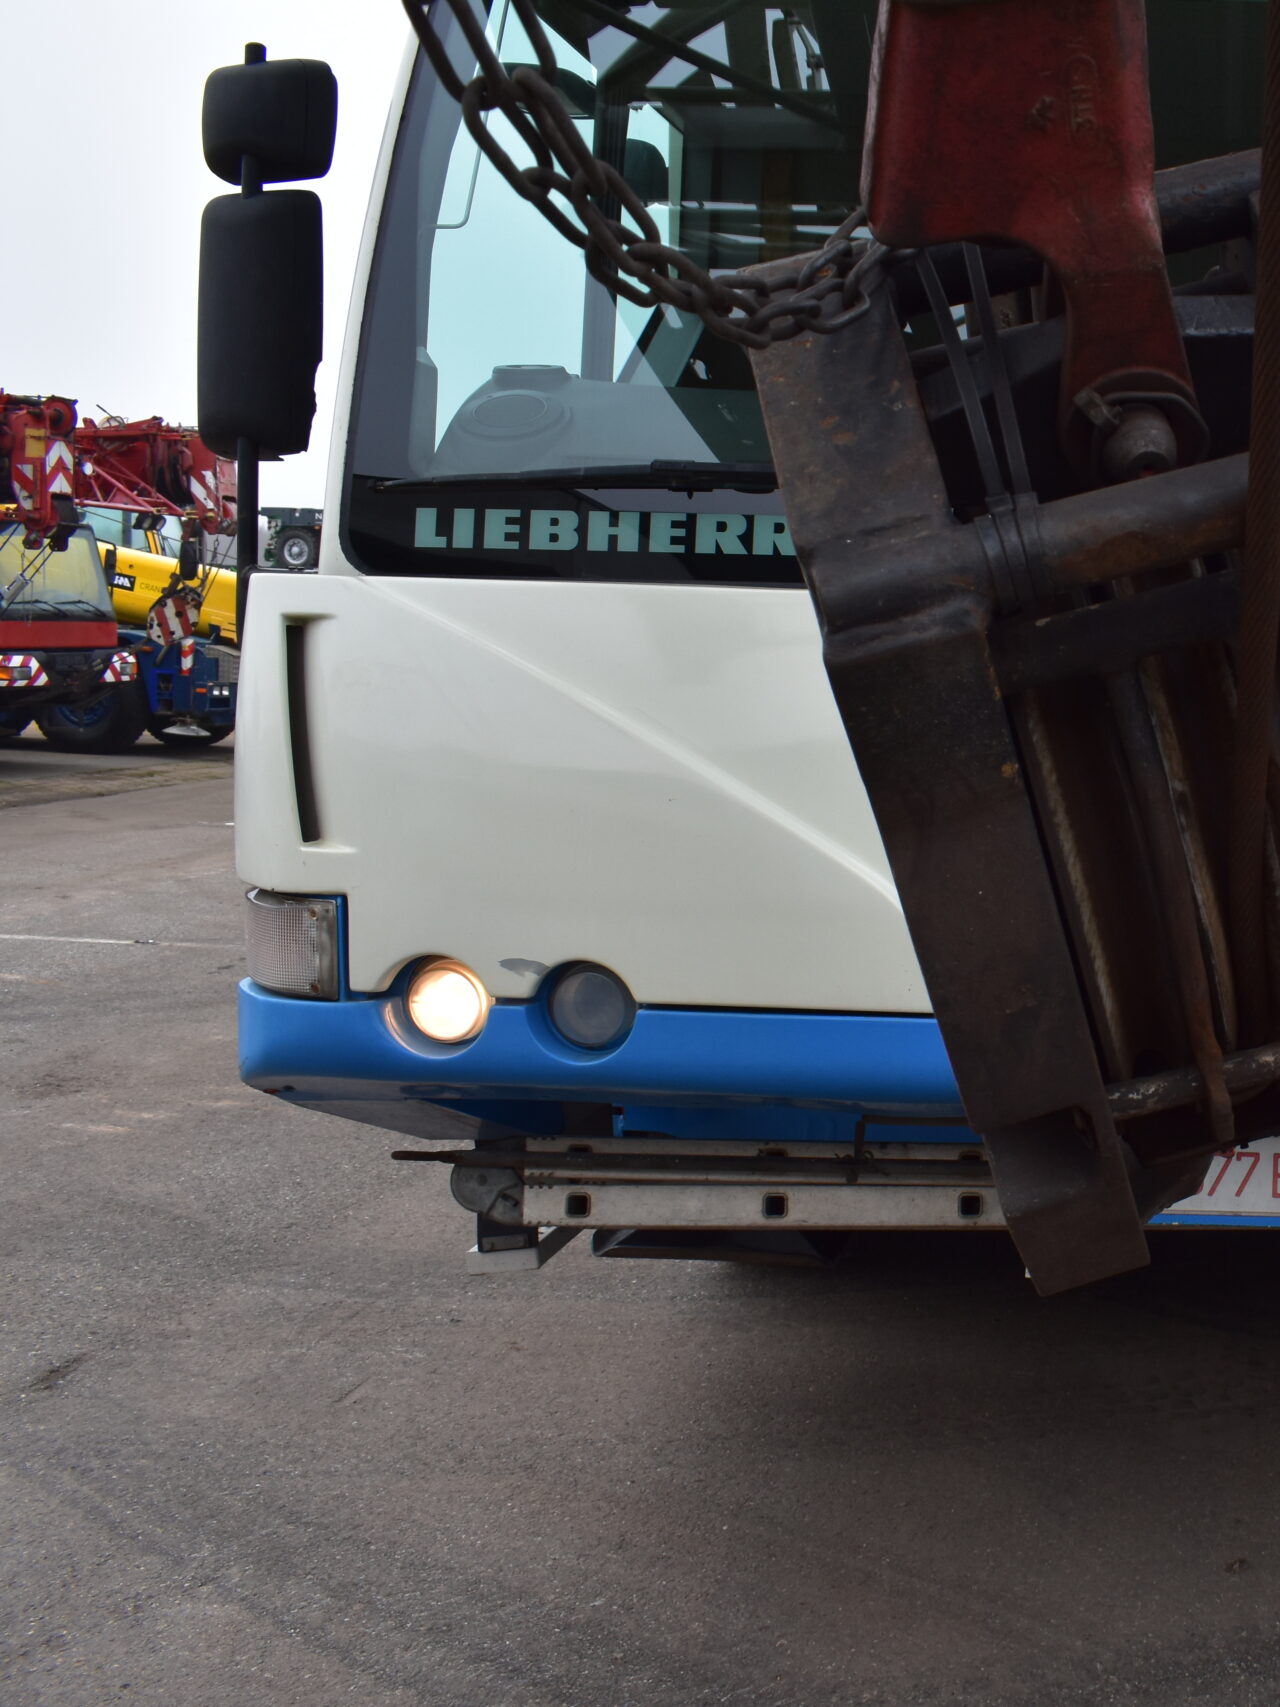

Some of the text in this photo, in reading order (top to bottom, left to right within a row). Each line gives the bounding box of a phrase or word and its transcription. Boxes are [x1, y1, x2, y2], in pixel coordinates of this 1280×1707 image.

[414, 507, 796, 556] LIEBHERR
[139, 582, 161, 593] CRAN
[1196, 1152, 1260, 1198] 77
